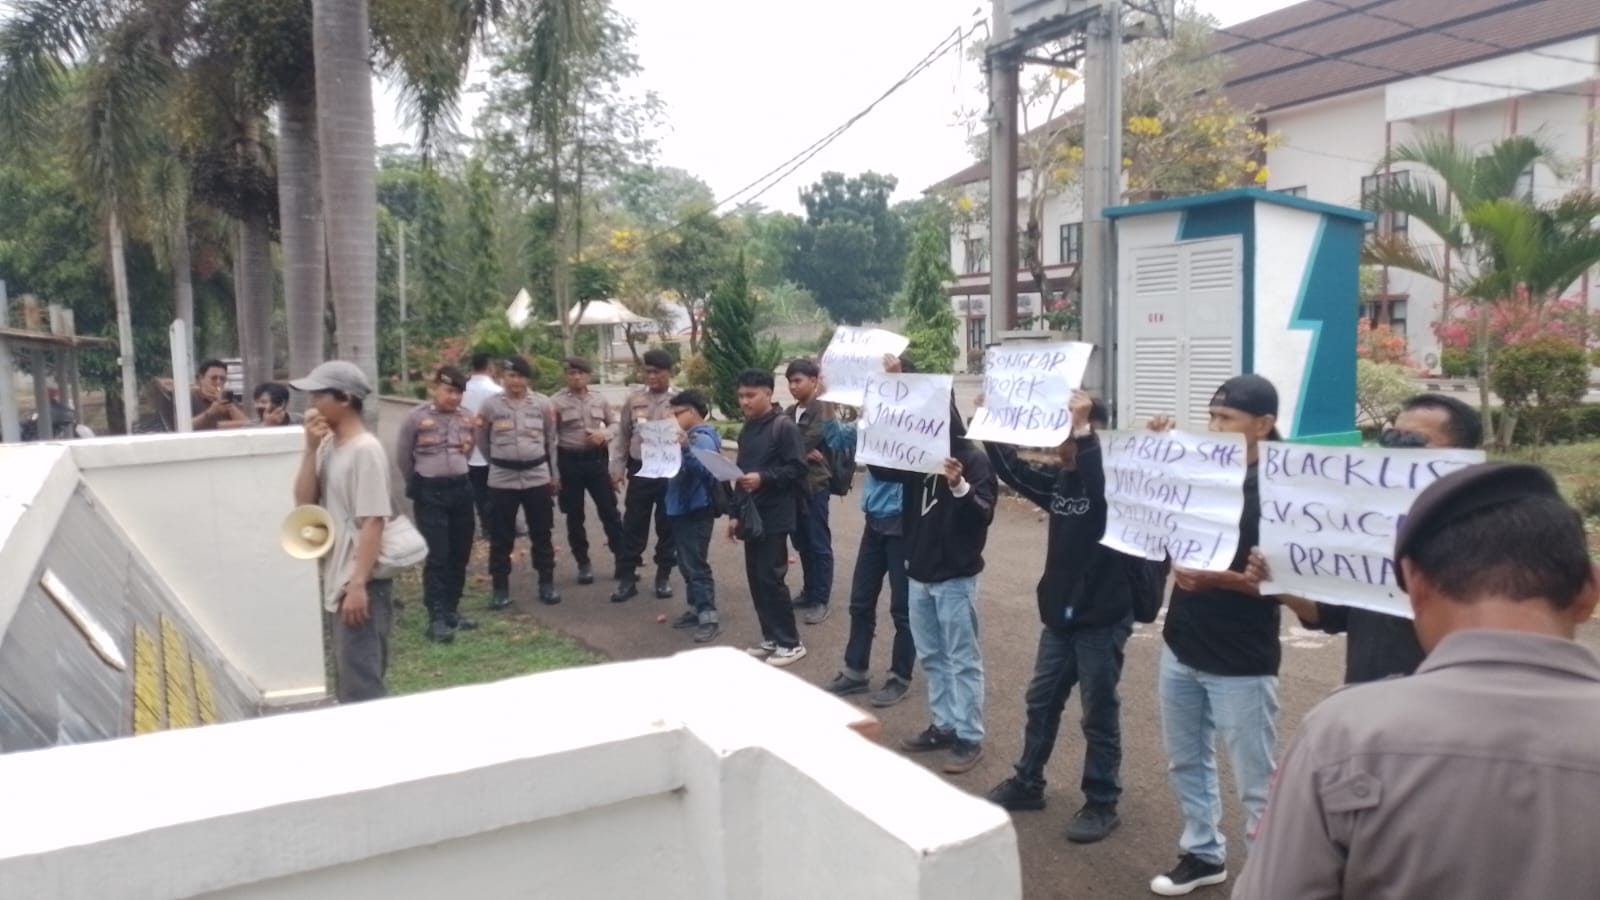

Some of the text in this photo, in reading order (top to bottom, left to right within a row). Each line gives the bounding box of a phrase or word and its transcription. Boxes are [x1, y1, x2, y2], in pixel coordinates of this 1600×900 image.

[868, 402, 945, 437] JANGAN
[1196, 441, 1242, 467] SMK
[1264, 447, 1475, 490] BLACKLIS
[1112, 500, 1177, 532] SALING
[1284, 541, 1397, 585] PRATA
